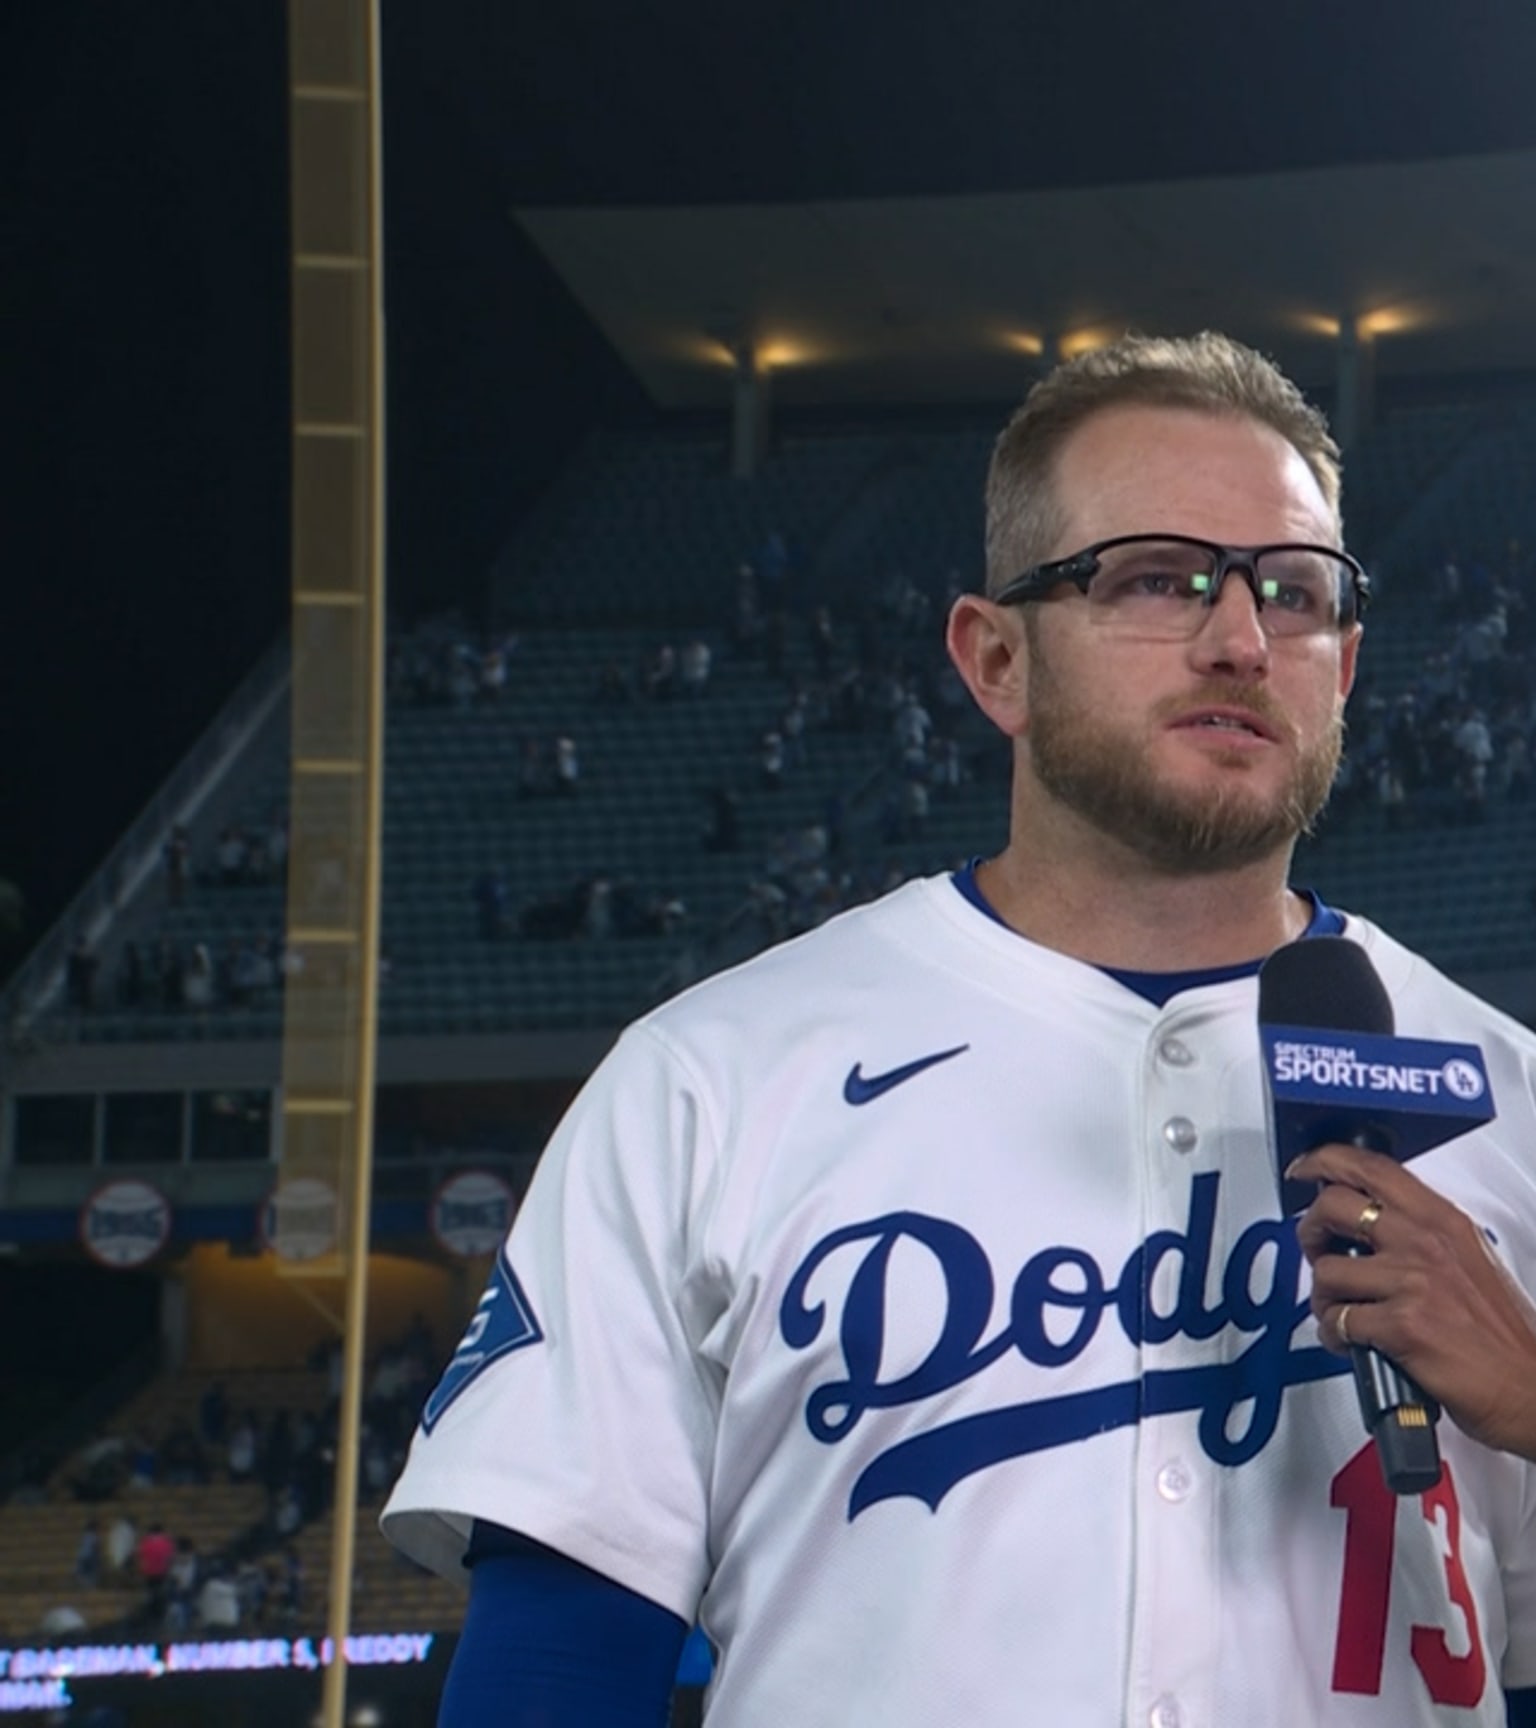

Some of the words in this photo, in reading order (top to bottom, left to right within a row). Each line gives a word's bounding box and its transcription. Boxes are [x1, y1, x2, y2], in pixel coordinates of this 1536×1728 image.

[1273, 1041, 1356, 1062] SPECTRUM
[1274, 1056, 1443, 1094] SPORTSNET
[779, 1171, 1498, 1468] Dodg
[1330, 1437, 1486, 1708] 13
